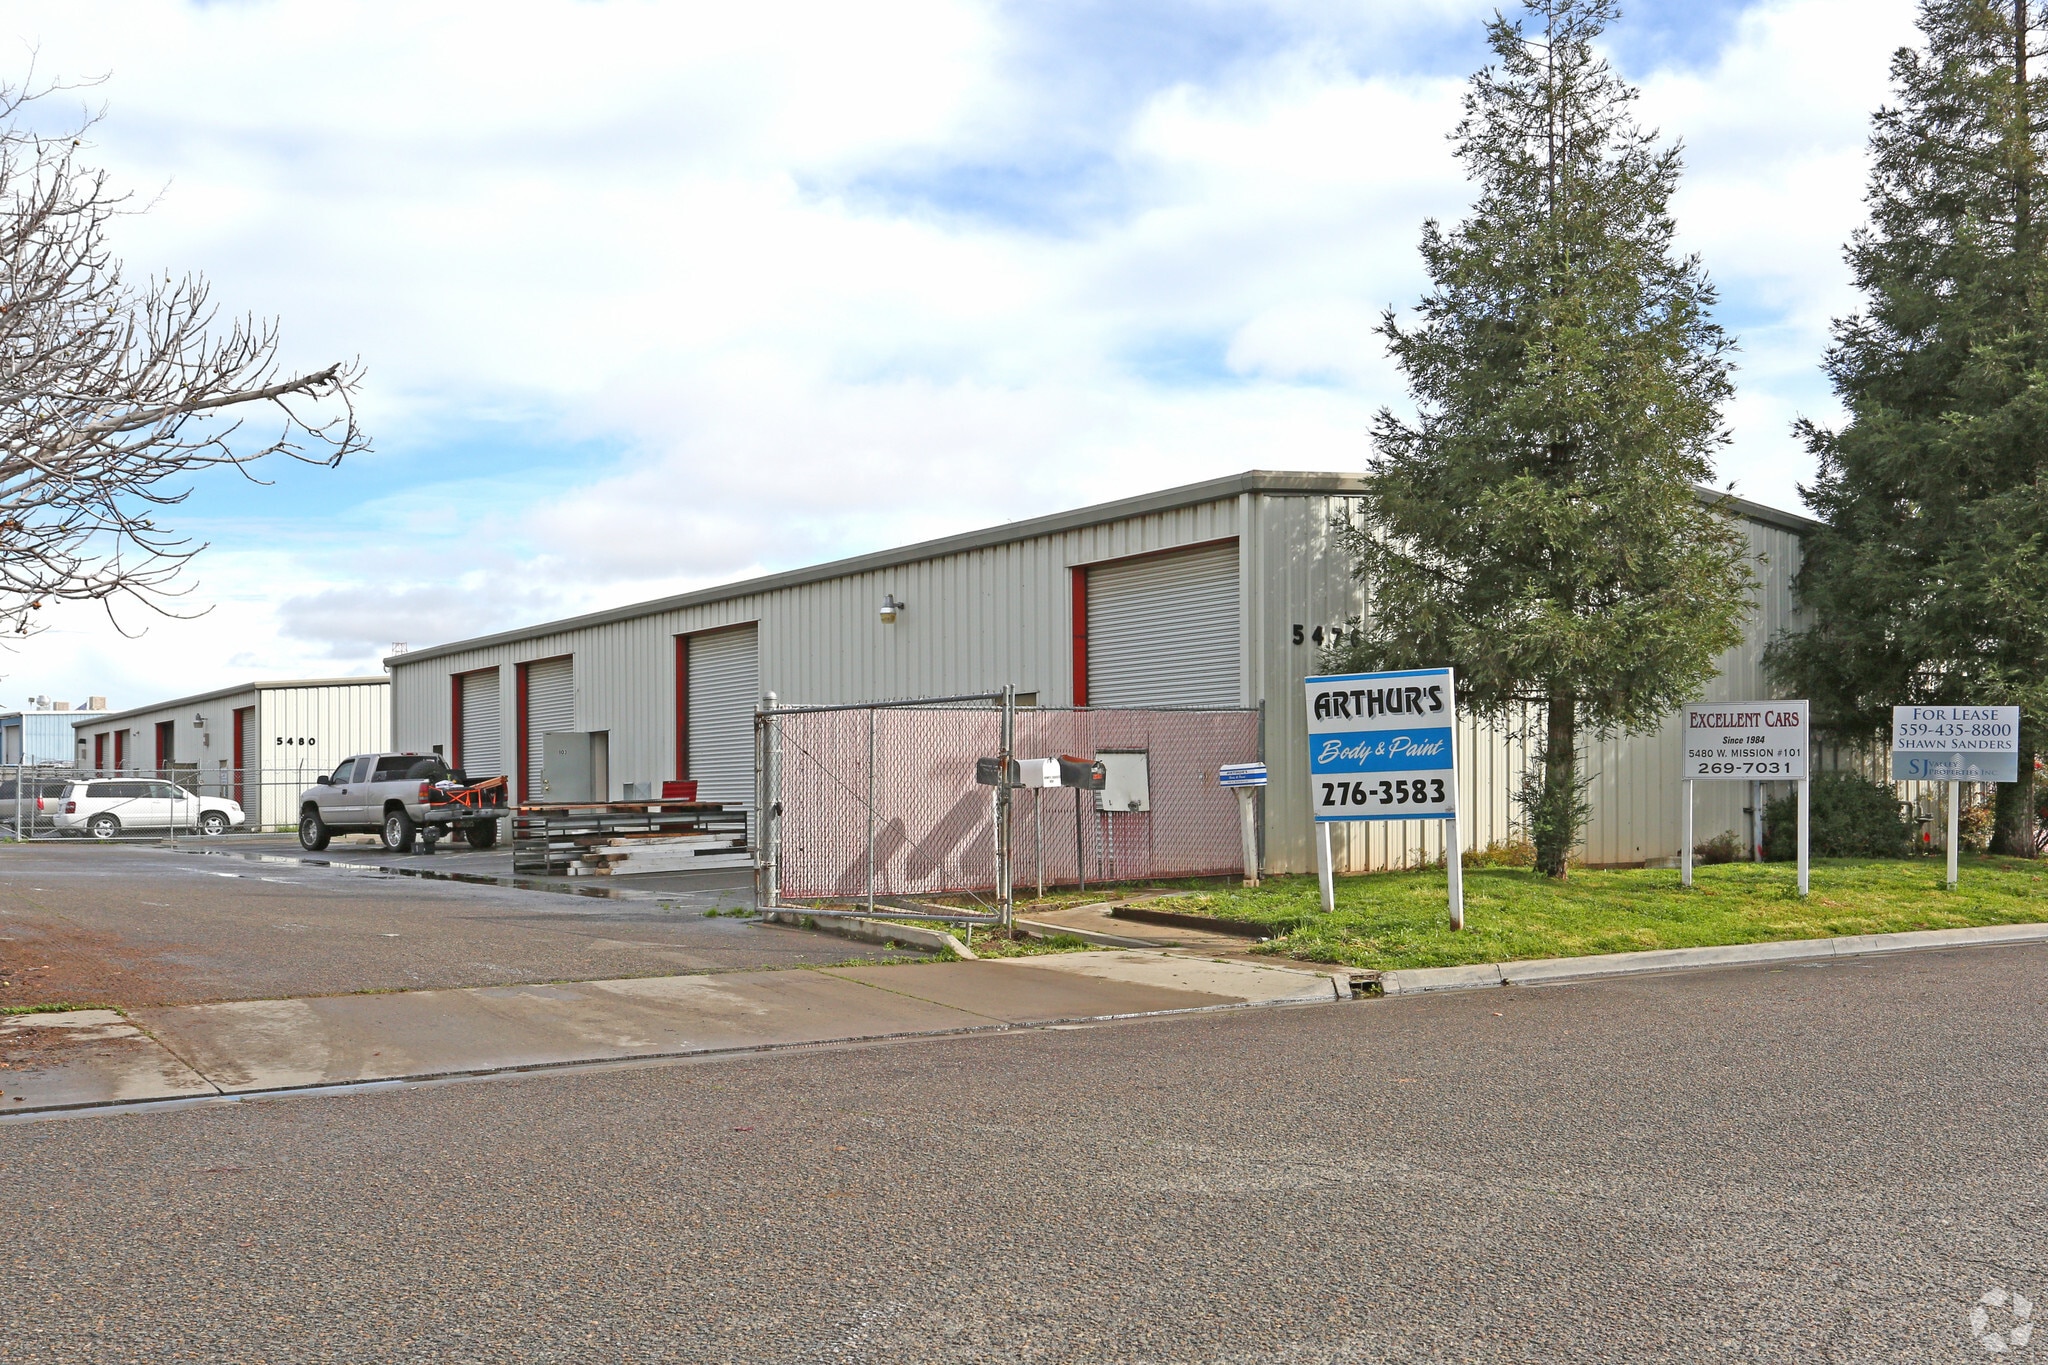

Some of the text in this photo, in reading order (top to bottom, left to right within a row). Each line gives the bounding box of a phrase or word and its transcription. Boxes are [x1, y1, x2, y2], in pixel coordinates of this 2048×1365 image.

[1314, 685, 1443, 722] ARTHUR'S
[1690, 710, 1799, 728] EXCELLENT CARS
[1913, 708, 1998, 720] FOR LEASE
[1900, 723, 2011, 736] 559-435-8800
[276, 737, 316, 746] 5480
[1722, 735, 1766, 744] Since 1984
[1898, 738, 2012, 749] SHAWN SANDERS
[1317, 736, 1445, 766] Body & Paint
[1688, 748, 1800, 758] 5480 W. MISSION #101
[1698, 762, 1790, 774] 269-7031
[1908, 758, 1928, 778] SJ
[1321, 778, 1446, 807] 276-3583
